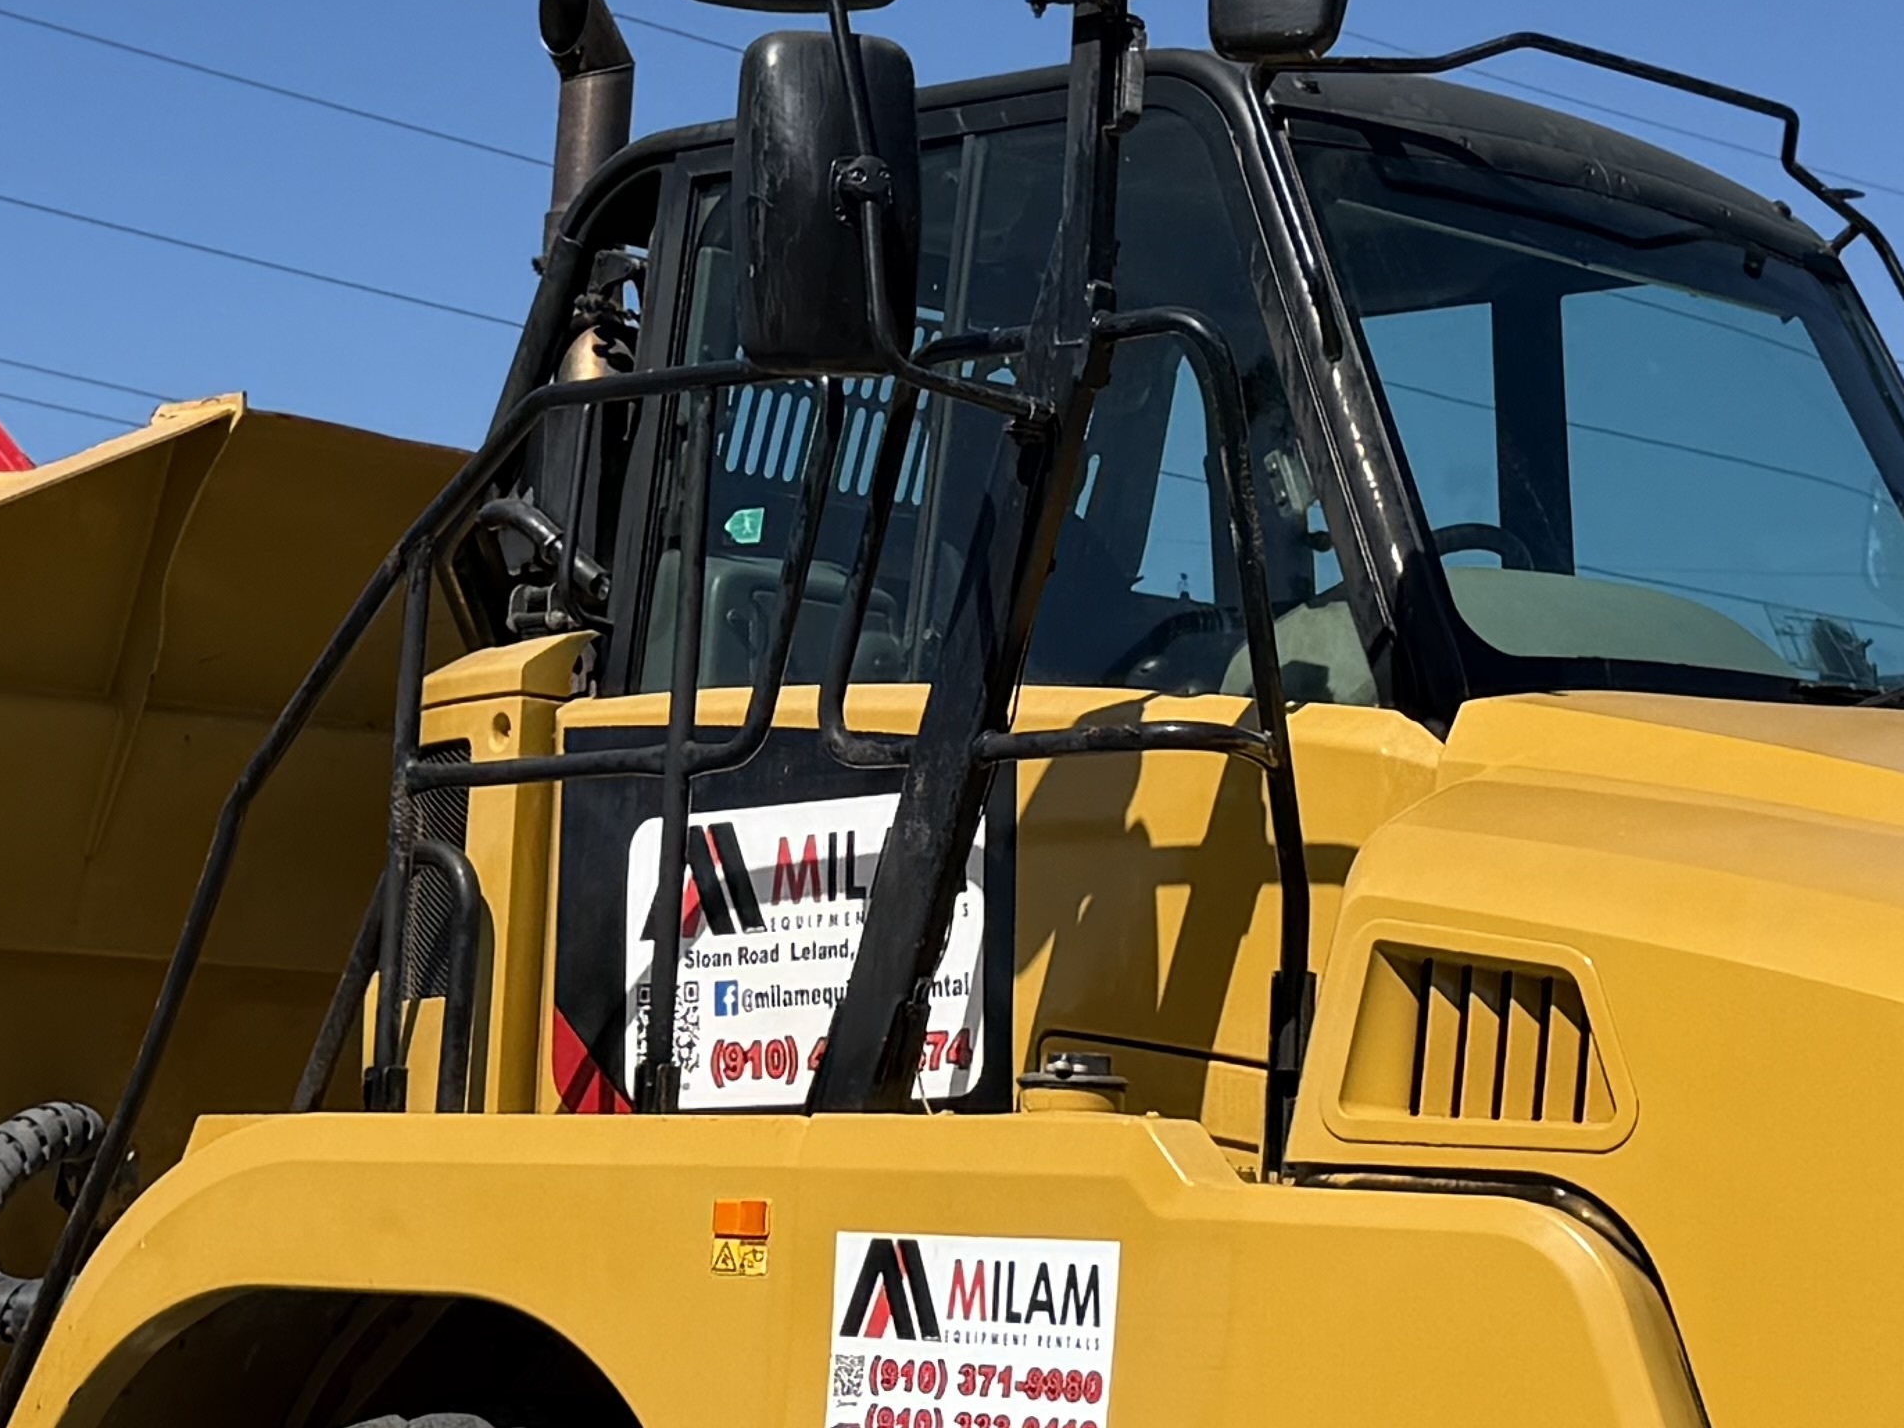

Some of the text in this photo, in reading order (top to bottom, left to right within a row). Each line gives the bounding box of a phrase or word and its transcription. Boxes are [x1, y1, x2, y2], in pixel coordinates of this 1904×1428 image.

[770, 830, 868, 906] MIL
[770, 911, 864, 932] EQUIPMEN
[684, 938, 856, 969] Sloan Road Leland,
[711, 1035, 799, 1088] (910)
[946, 1258, 1101, 1328] MILAM
[944, 1329, 1100, 1351] EQUIPMENT RENTALS
[869, 1355, 948, 1400] (910)
